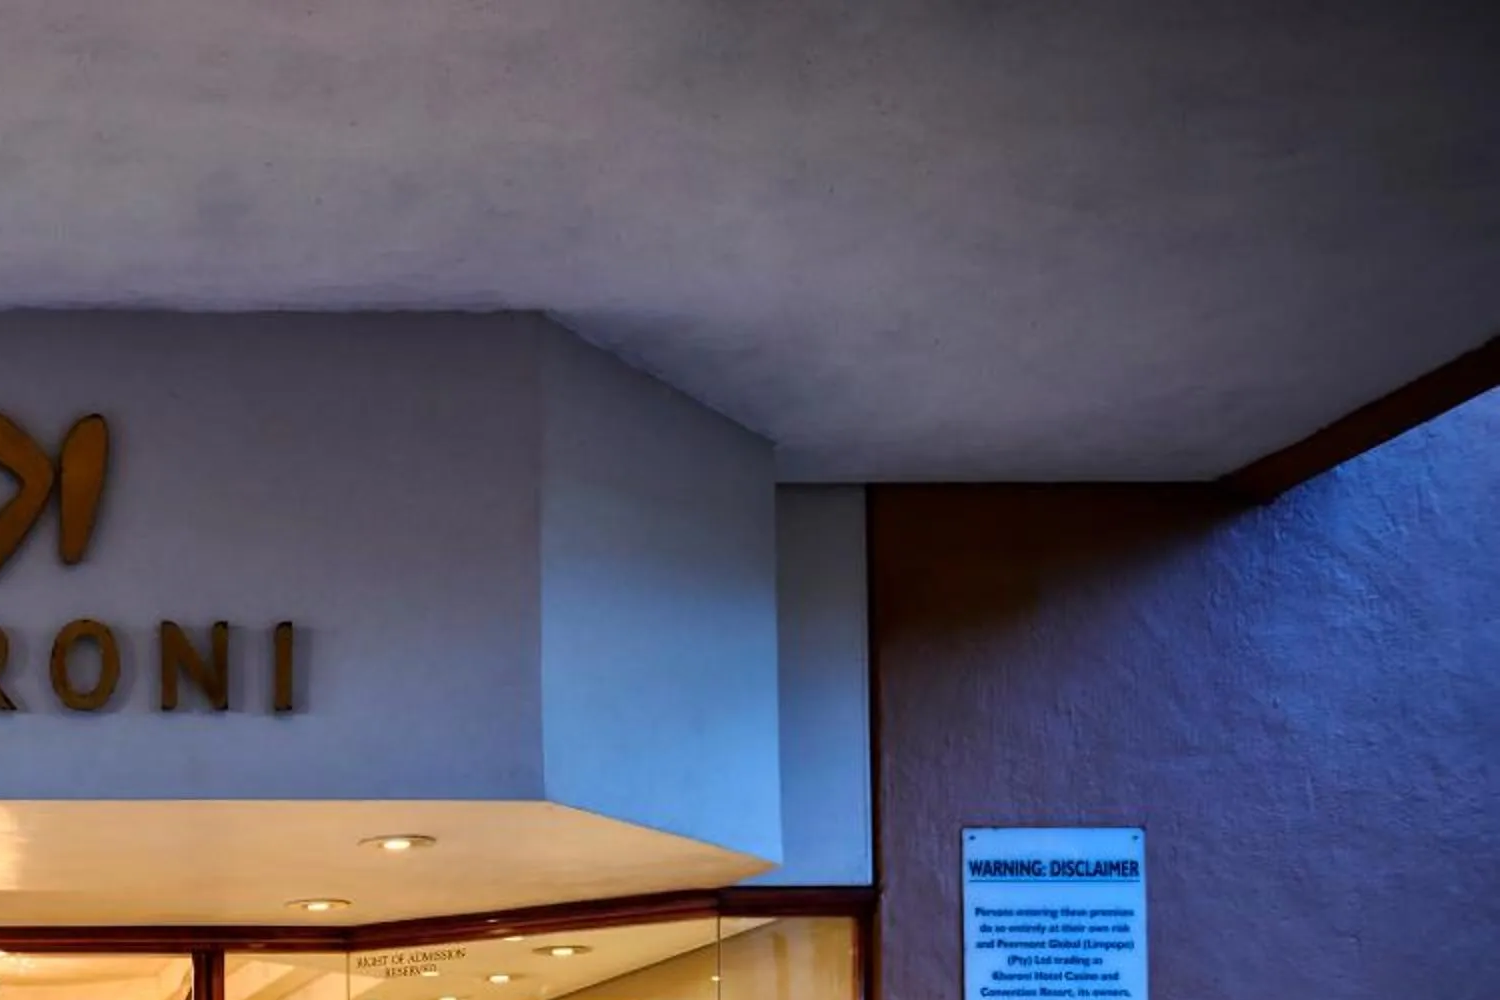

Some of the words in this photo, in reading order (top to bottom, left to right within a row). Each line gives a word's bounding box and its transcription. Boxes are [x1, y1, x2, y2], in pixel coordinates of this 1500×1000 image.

[969, 860, 1046, 877] WARNING:
[1051, 860, 1139, 877] DISCLAIMER
[357, 956, 388, 968] RIGHT
[392, 953, 404, 964] OF
[407, 948, 466, 964] ADMISSION
